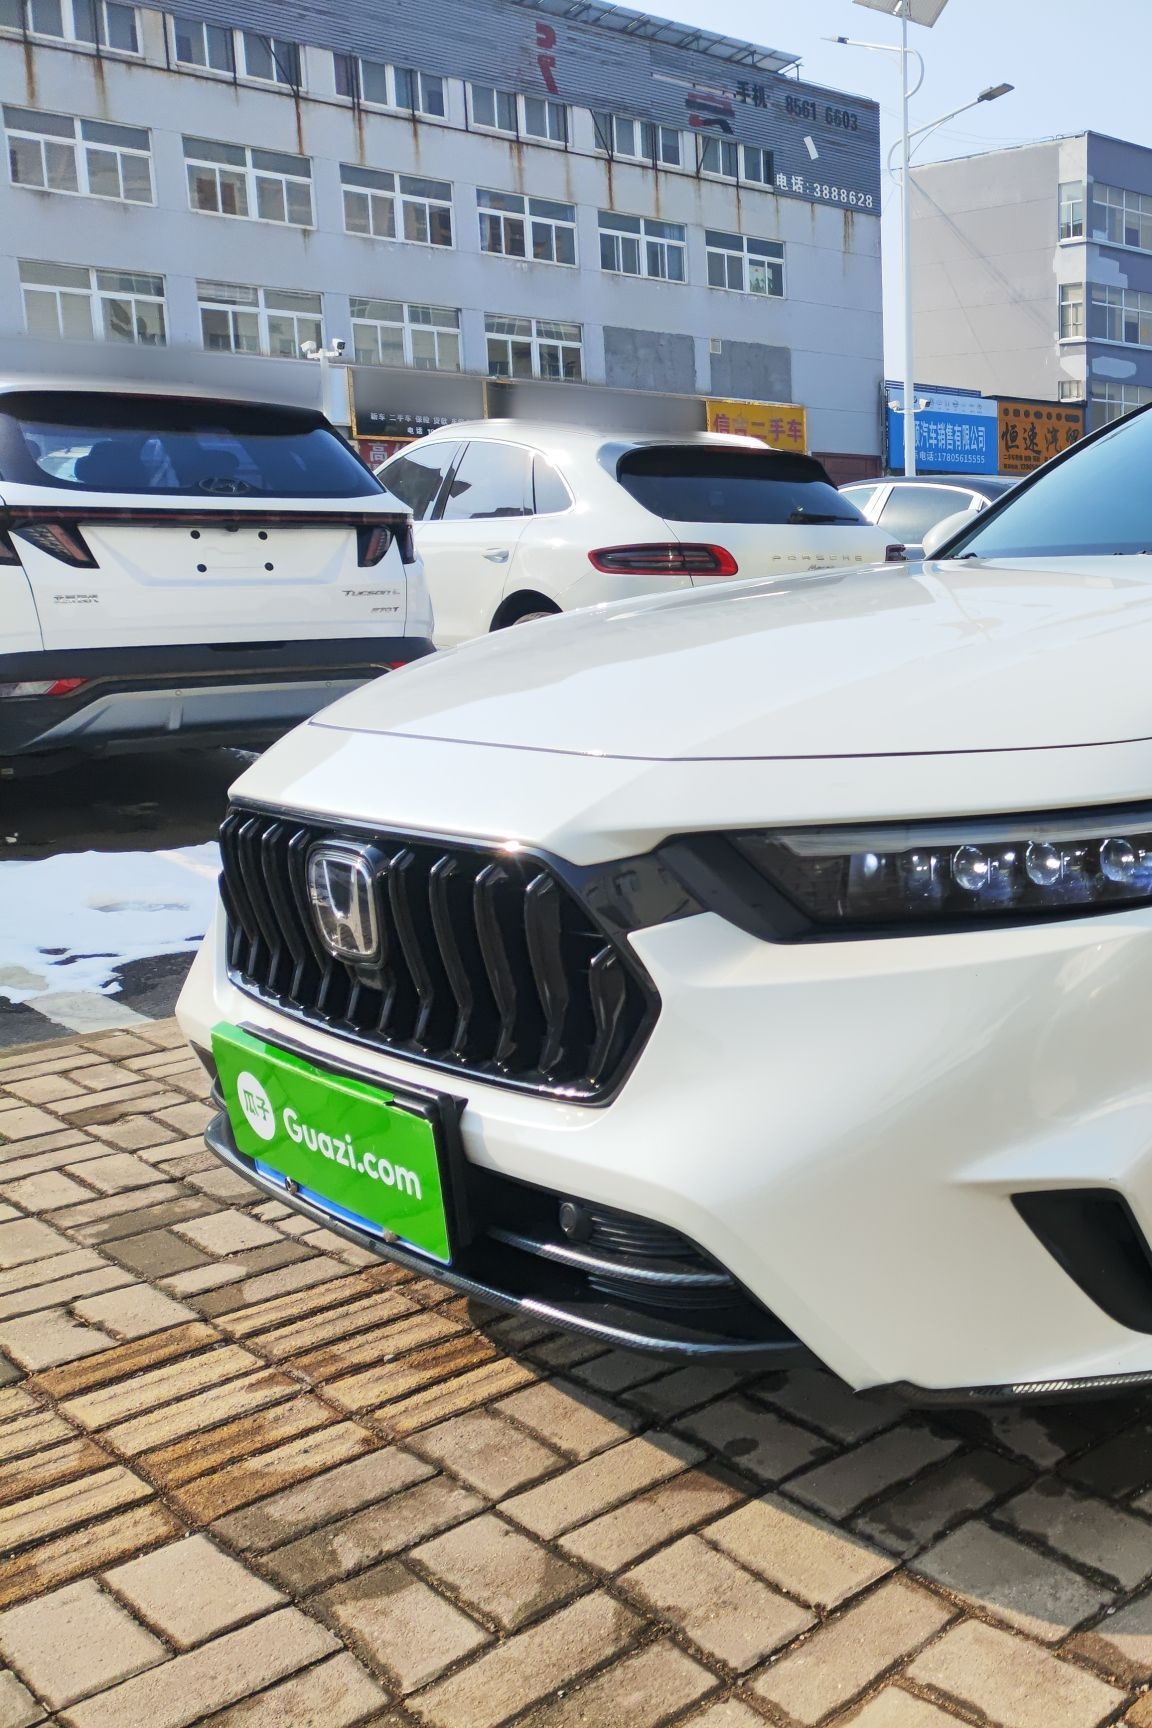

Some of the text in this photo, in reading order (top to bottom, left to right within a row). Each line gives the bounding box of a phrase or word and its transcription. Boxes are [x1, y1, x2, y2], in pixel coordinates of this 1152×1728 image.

[407, 426, 423, 435] 电话
[242, 1089, 269, 1122] 瓜子
[283, 1107, 422, 1200] Guazi.com
